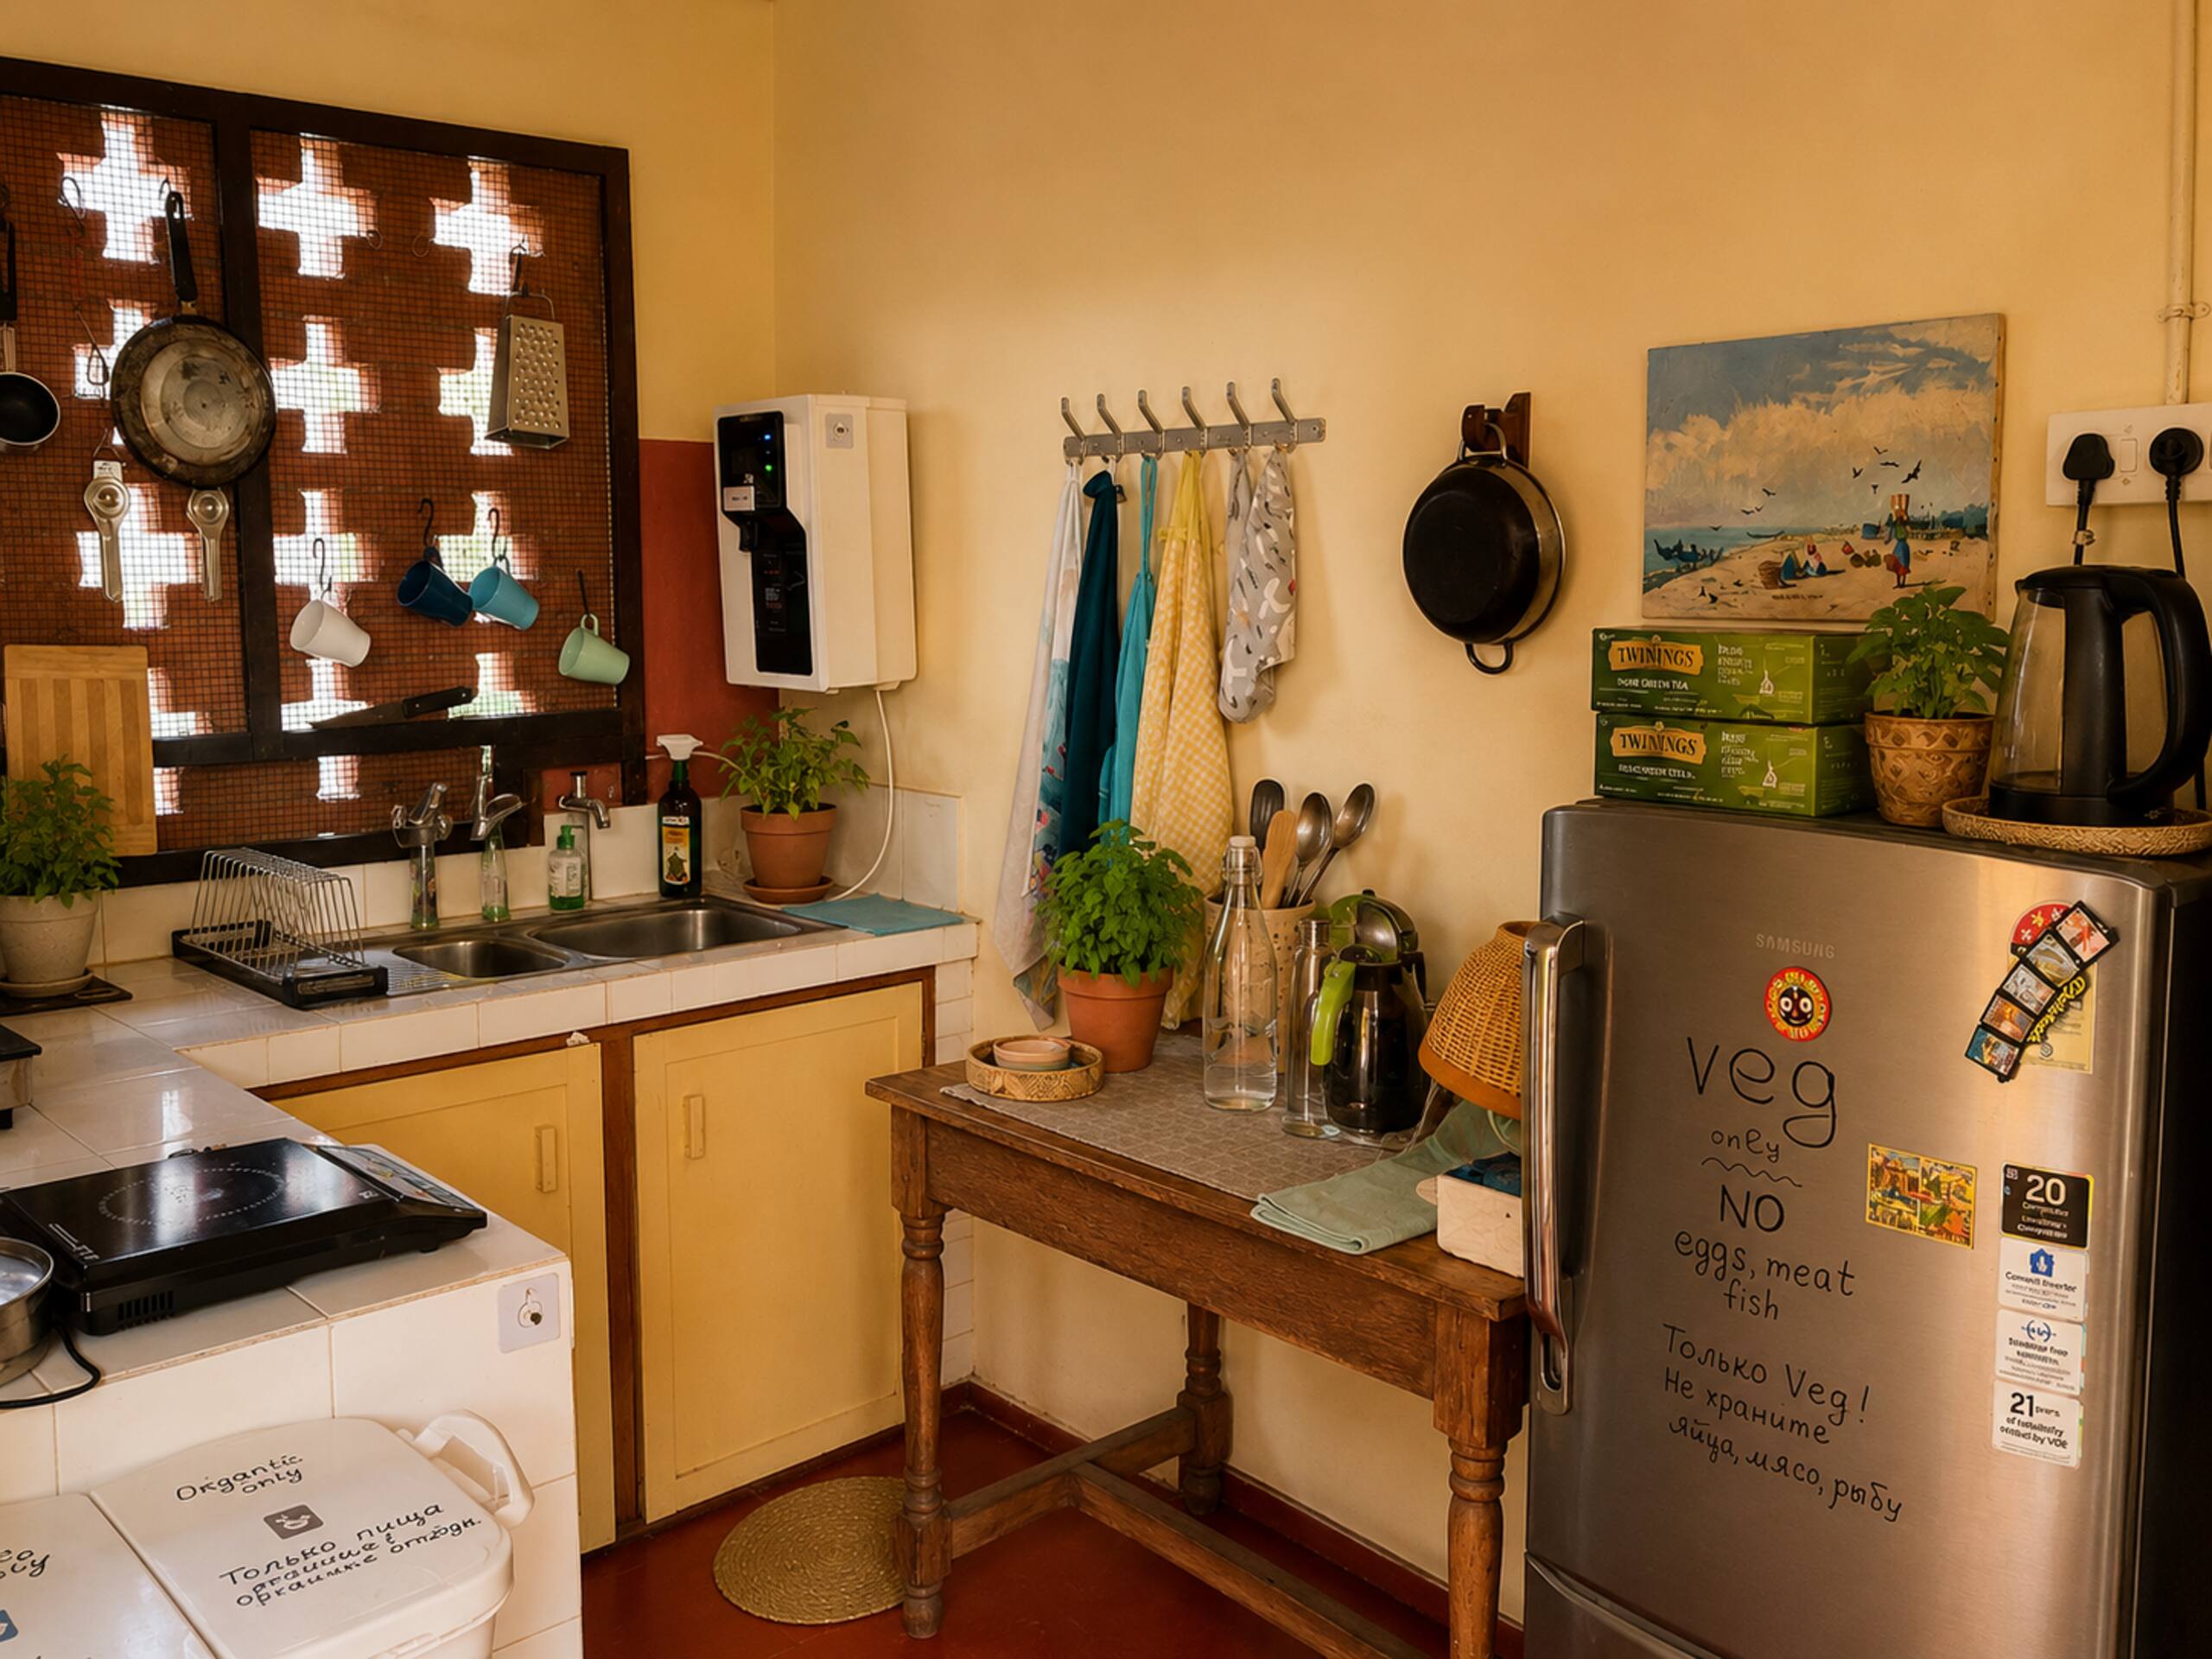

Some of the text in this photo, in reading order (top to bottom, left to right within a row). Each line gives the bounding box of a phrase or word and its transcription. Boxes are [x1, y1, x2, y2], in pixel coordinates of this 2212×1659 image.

[1756, 933, 1835, 959] SAMSUNG
[1719, 1184, 1785, 1232] NO
[2025, 1173, 2066, 1206] 20
[1723, 1278, 1780, 1320] fish
[1766, 1260, 1856, 1296] meat
[1662, 1323, 1768, 1384] Только
[1706, 1388, 1830, 1445] храните
[2010, 1391, 2034, 1417] 21
[219, 1503, 444, 1585] Только пища
